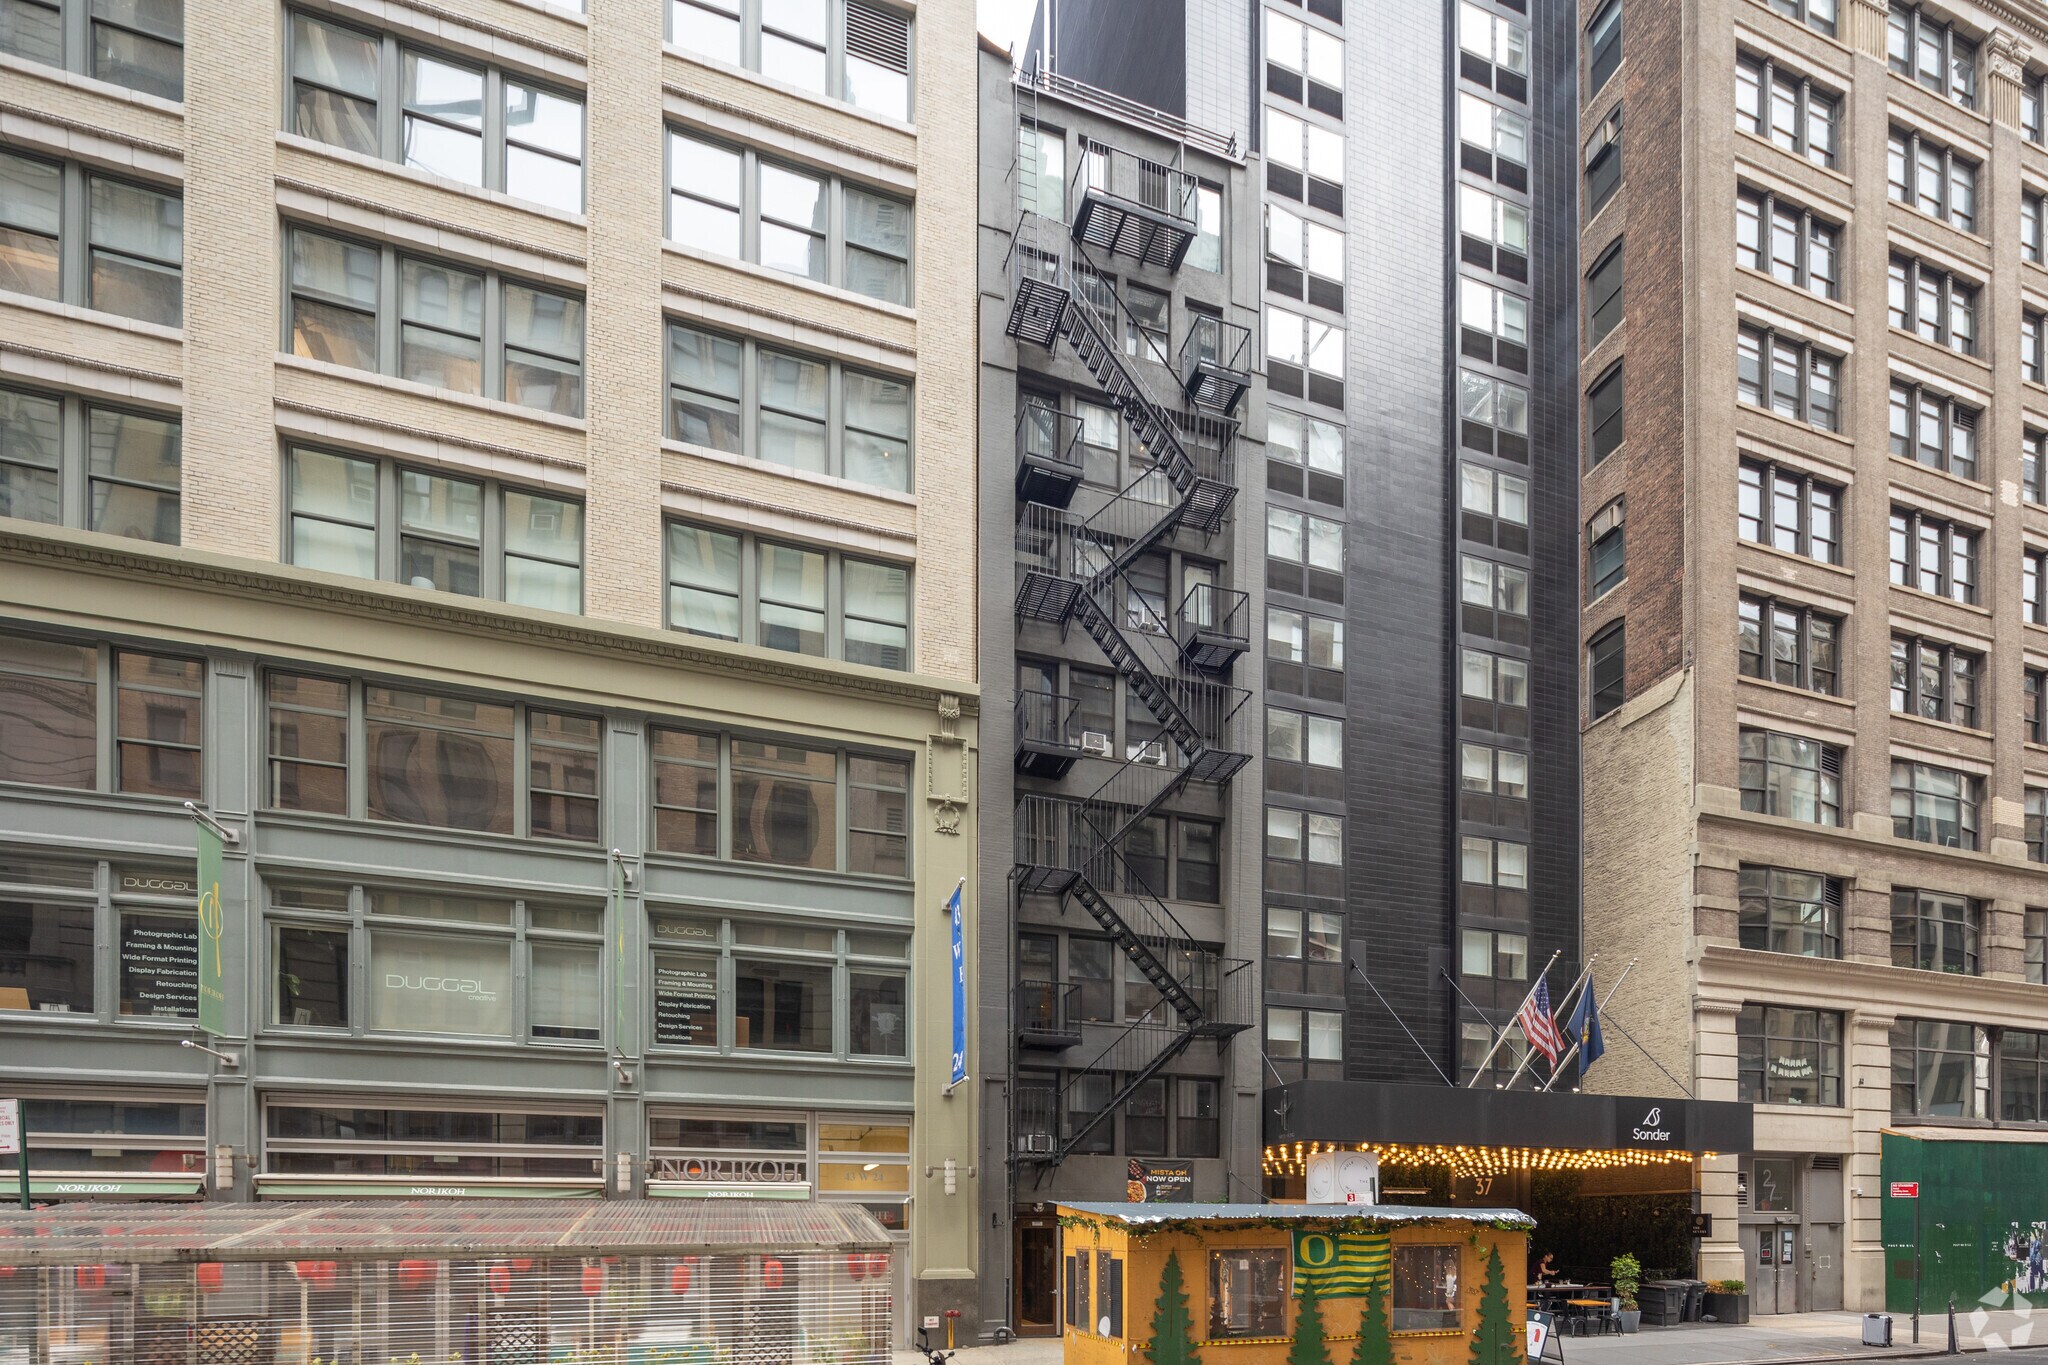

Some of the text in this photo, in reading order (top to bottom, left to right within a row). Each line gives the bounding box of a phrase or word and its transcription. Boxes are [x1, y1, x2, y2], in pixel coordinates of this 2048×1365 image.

[133, 929, 183, 939] Photographic
[126, 941, 156, 951] Framing
[163, 944, 198, 953] Mounting
[122, 953, 198, 965] Wide Format Printing
[129, 966, 198, 977] Display Fabrication
[658, 968, 696, 978] Photographic
[156, 980, 198, 990] Retouching
[658, 979, 681, 988] Framing
[686, 981, 713, 989] Mounting
[139, 991, 198, 1001] Design Services
[468, 994, 497, 1002] creative
[694, 992, 716, 1000] Printing
[153, 1004, 198, 1014] Installations
[658, 1001, 711, 1010] Display Fabrication
[658, 1012, 691, 1020] Retouching
[658, 1022, 703, 1031] Design Services
[658, 1033, 692, 1041] Installations
[952, 1050, 963, 1072] 24
[1632, 1127, 1670, 1142] Sonder
[658, 1157, 802, 1183] NORIKOH
[55, 1184, 122, 1193] NORIKOH
[410, 1187, 466, 1195] NORIKOH
[1475, 1178, 1493, 1195] 37
[707, 1190, 754, 1198] NORIKOH
[1300, 1234, 1334, 1266] O
